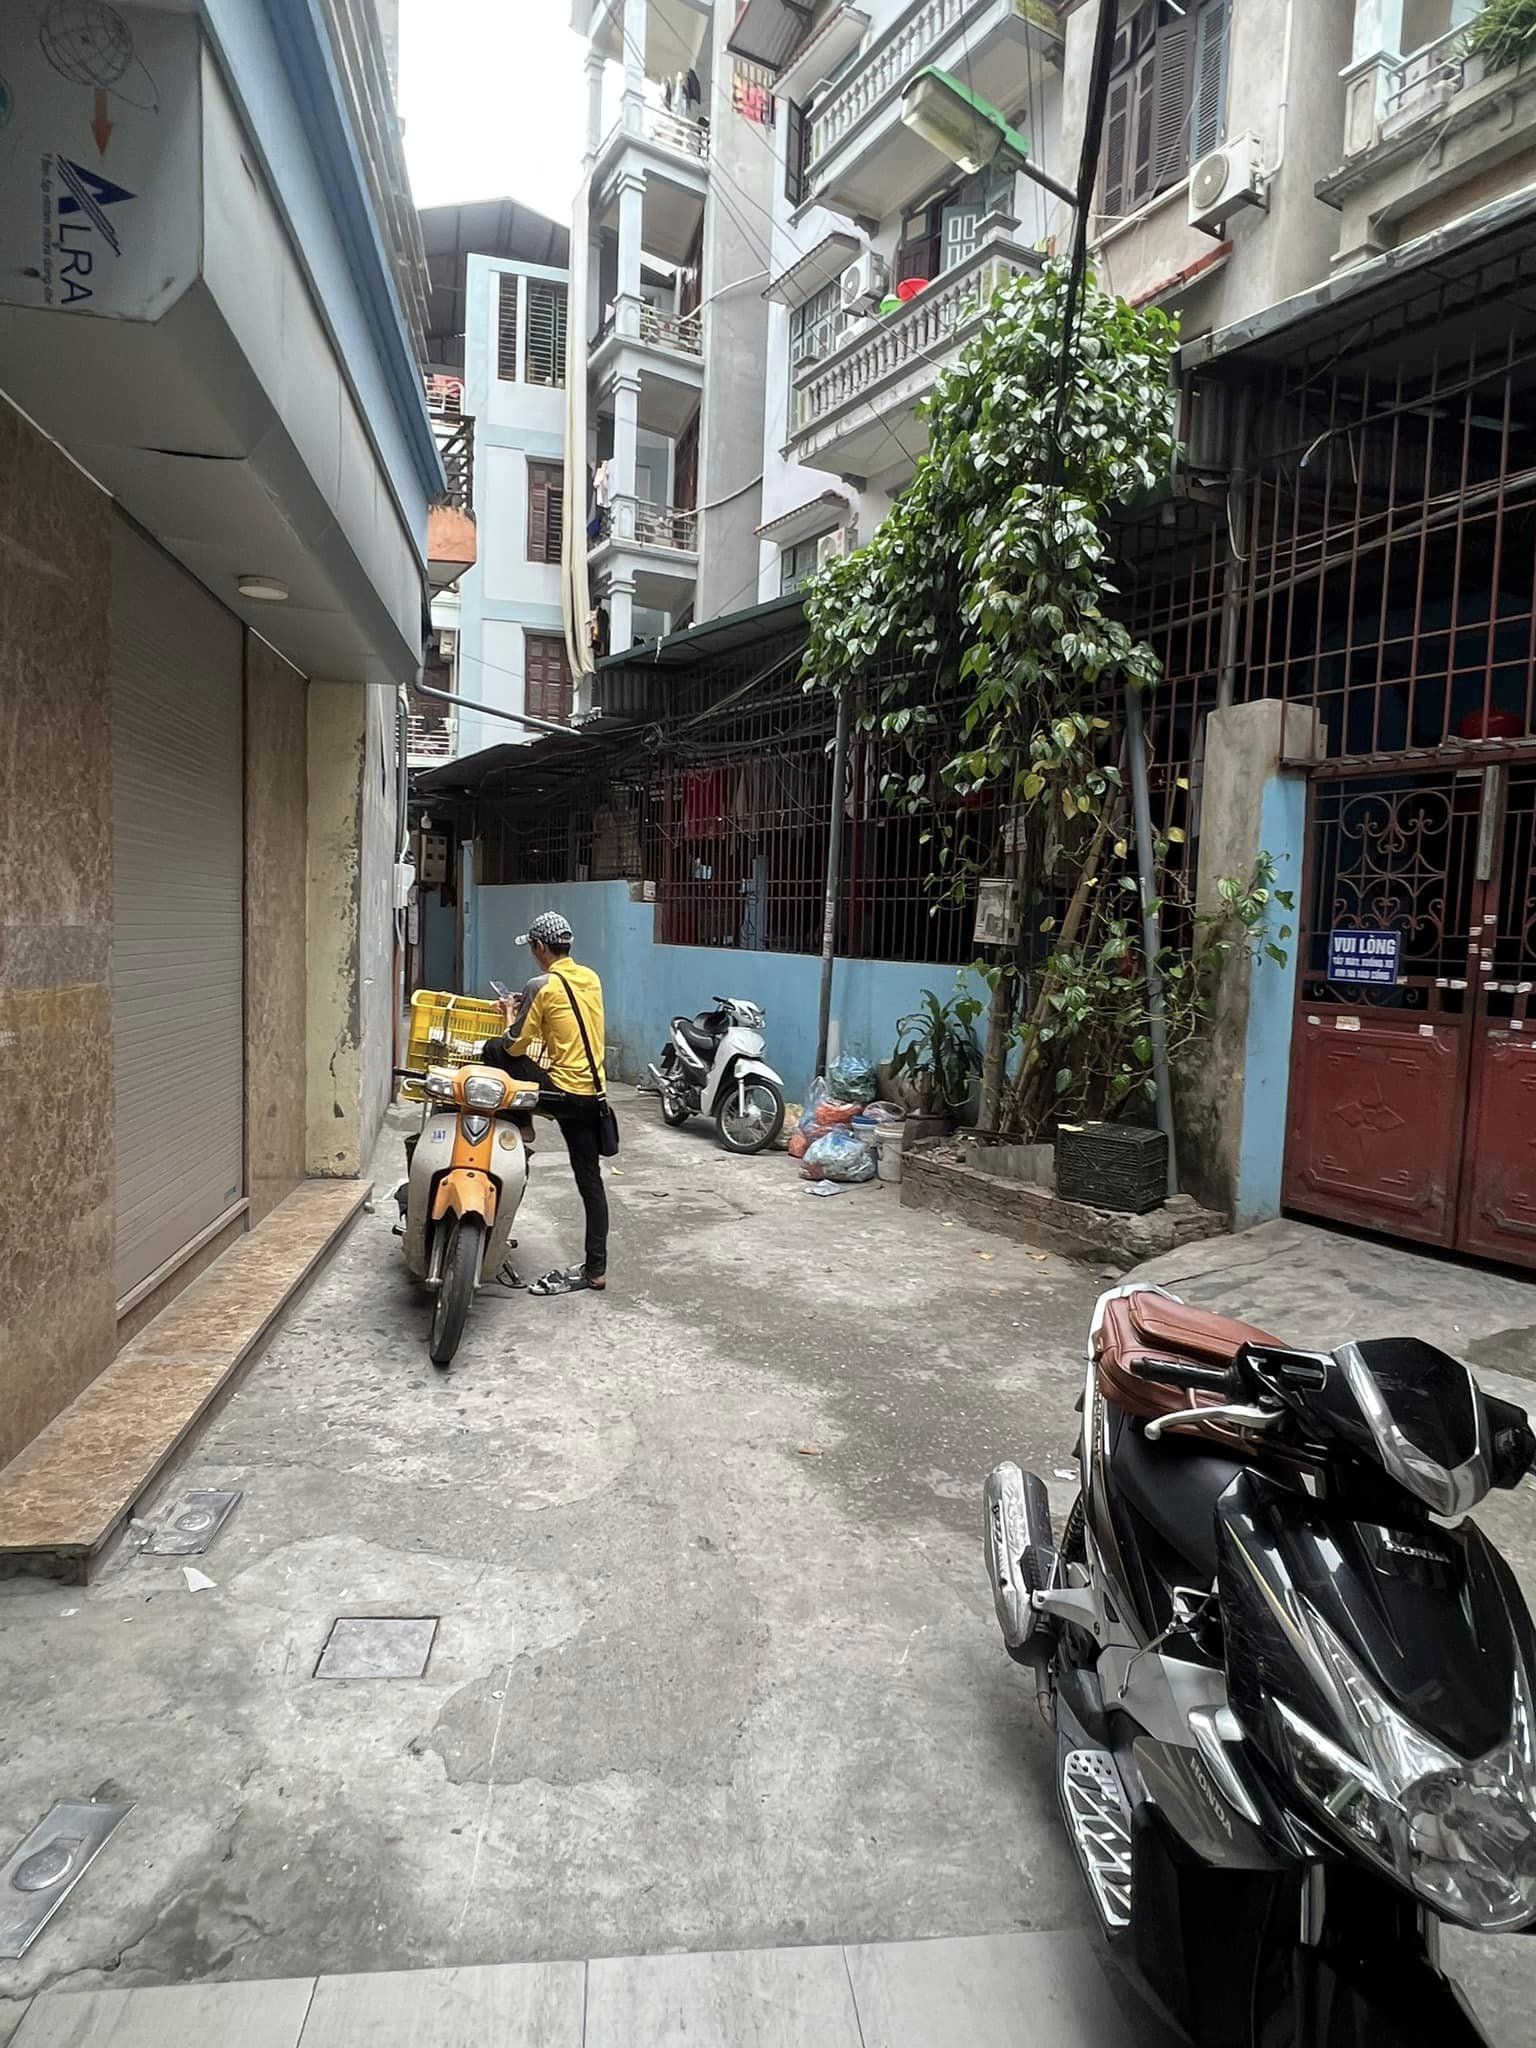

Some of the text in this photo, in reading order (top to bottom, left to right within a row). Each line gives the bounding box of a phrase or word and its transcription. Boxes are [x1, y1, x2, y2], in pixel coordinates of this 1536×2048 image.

[1334, 934, 1396, 955] VUI LÒNG
[1190, 1756, 1233, 1840] HONDA
